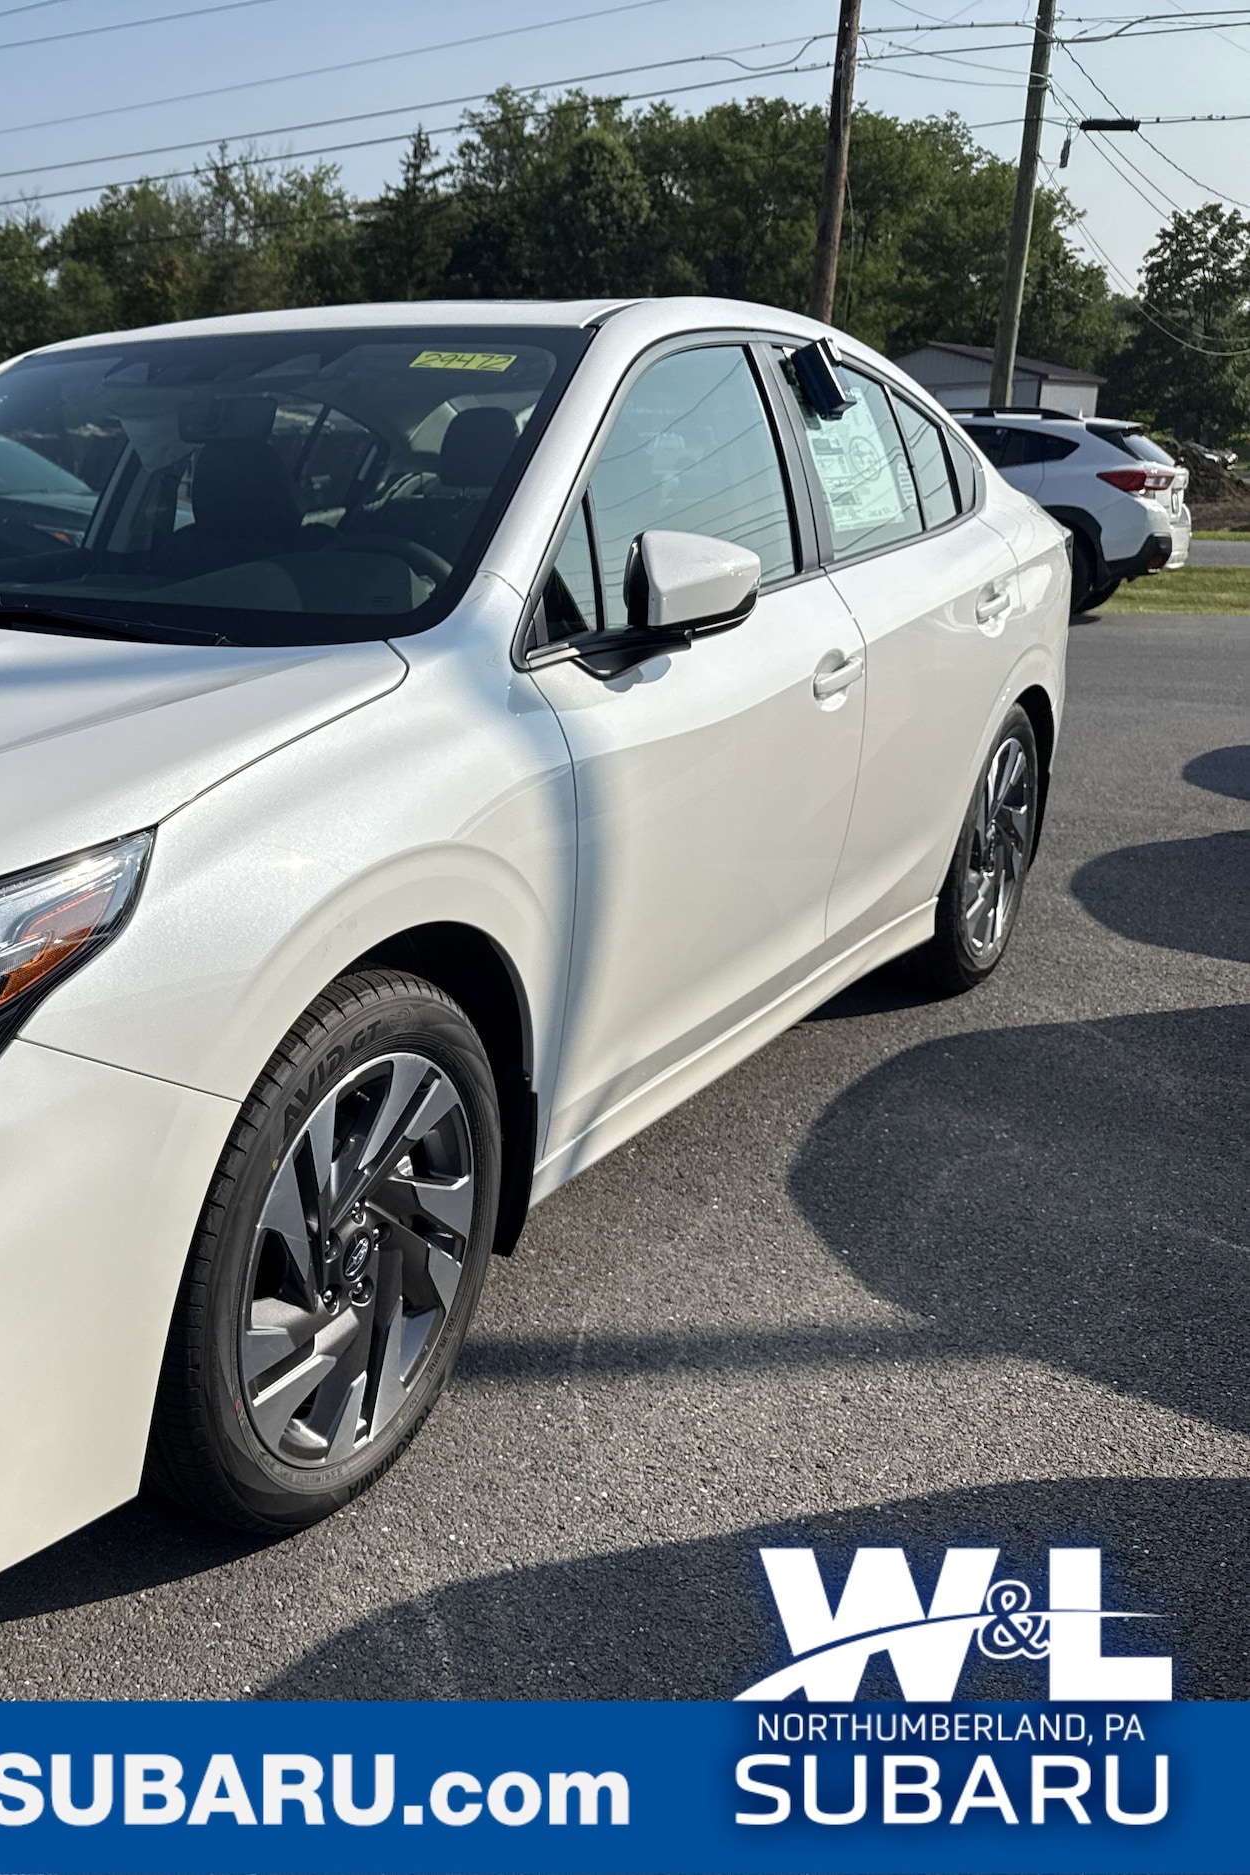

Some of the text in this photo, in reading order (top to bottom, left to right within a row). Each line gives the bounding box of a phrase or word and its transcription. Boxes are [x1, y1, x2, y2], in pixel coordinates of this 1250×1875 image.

[413, 353, 512, 370] 29472
[283, 1019, 382, 1143] AVID GT
[347, 1405, 432, 1500] YOKOHAMA
